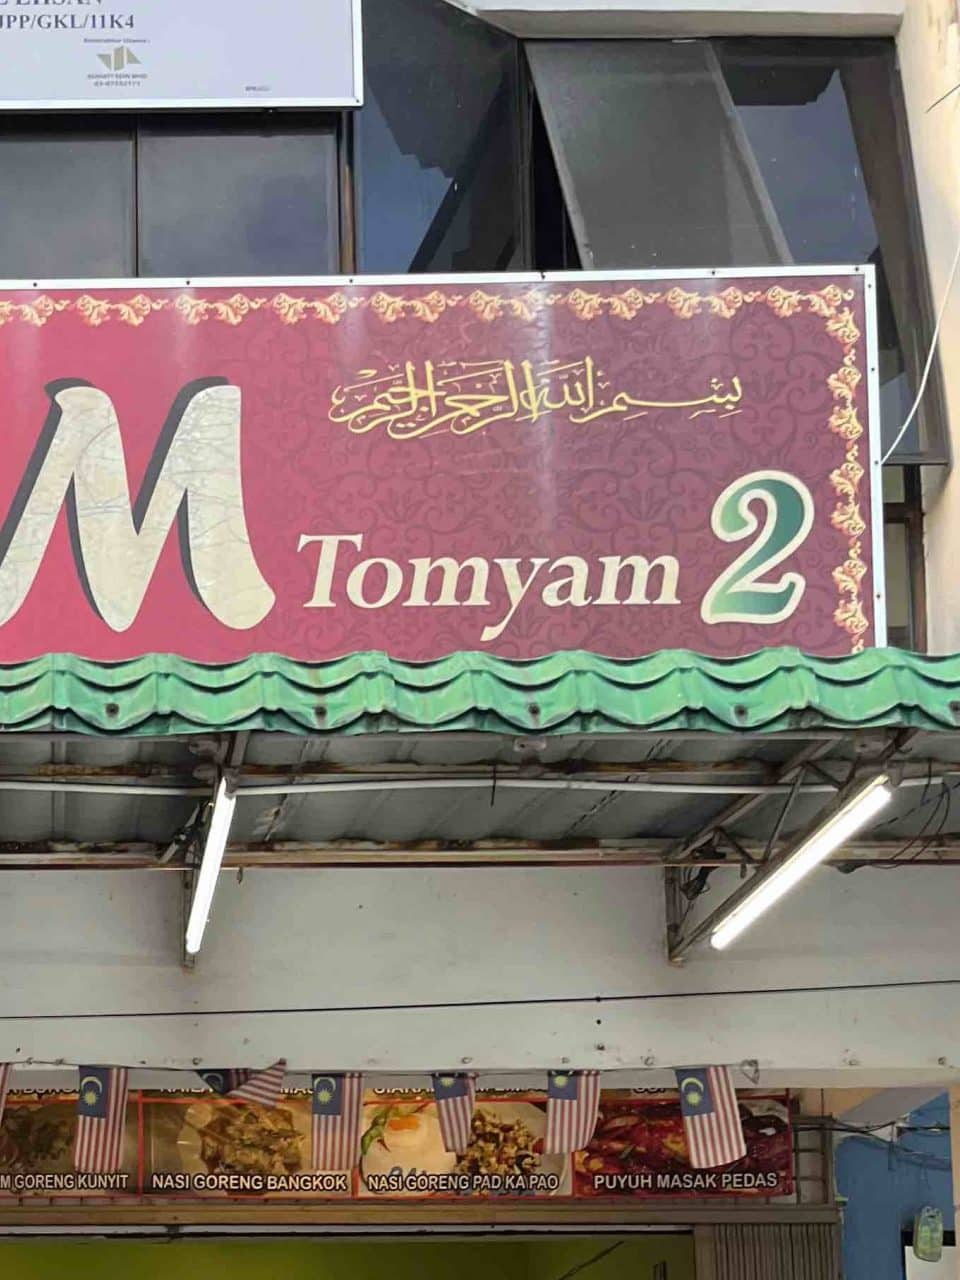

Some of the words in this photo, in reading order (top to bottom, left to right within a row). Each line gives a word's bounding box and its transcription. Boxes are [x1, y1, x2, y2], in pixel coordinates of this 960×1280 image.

[297, 531, 681, 642] Tomyam
[701, 469, 815, 625] 2
[14, 1174, 75, 1189] GORENG
[77, 1174, 129, 1188] KUNYIT
[152, 1175, 189, 1189] NASI
[194, 1175, 264, 1189] GORENG
[266, 1175, 347, 1190] BANGKOK
[368, 1175, 403, 1190] NASI
[406, 1175, 469, 1190] GORENG
[472, 1175, 502, 1190] PAD
[505, 1175, 525, 1190] KA
[527, 1175, 559, 1190] PAO
[594, 1174, 652, 1190] PUYUH
[657, 1174, 717, 1188] MASAK
[722, 1173, 778, 1188] PEDAS
